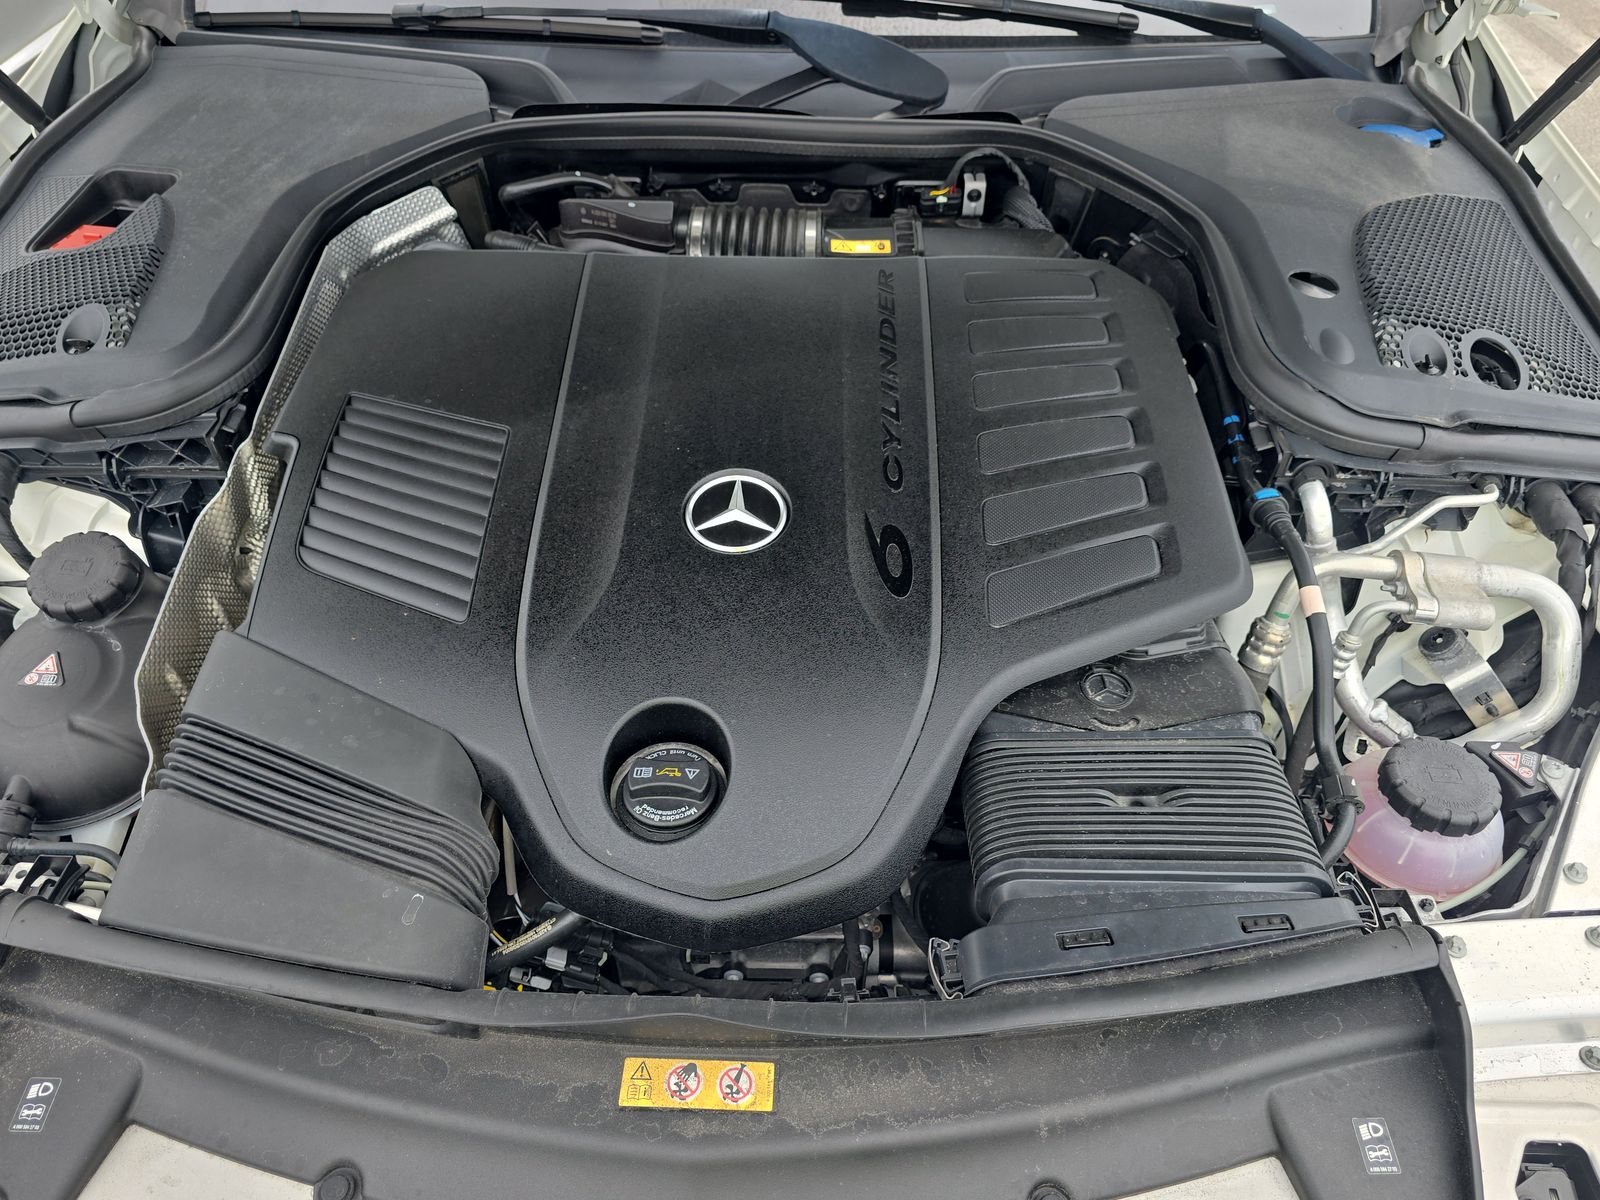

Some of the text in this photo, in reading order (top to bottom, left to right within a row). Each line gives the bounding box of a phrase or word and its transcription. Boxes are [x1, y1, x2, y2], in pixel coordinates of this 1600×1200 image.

[863, 268, 915, 600] 6 CYLINDER
[645, 750, 667, 760] CLICK
[633, 805, 698, 821] Mercedes-Benz Oil
[642, 804, 689, 815] recommended
